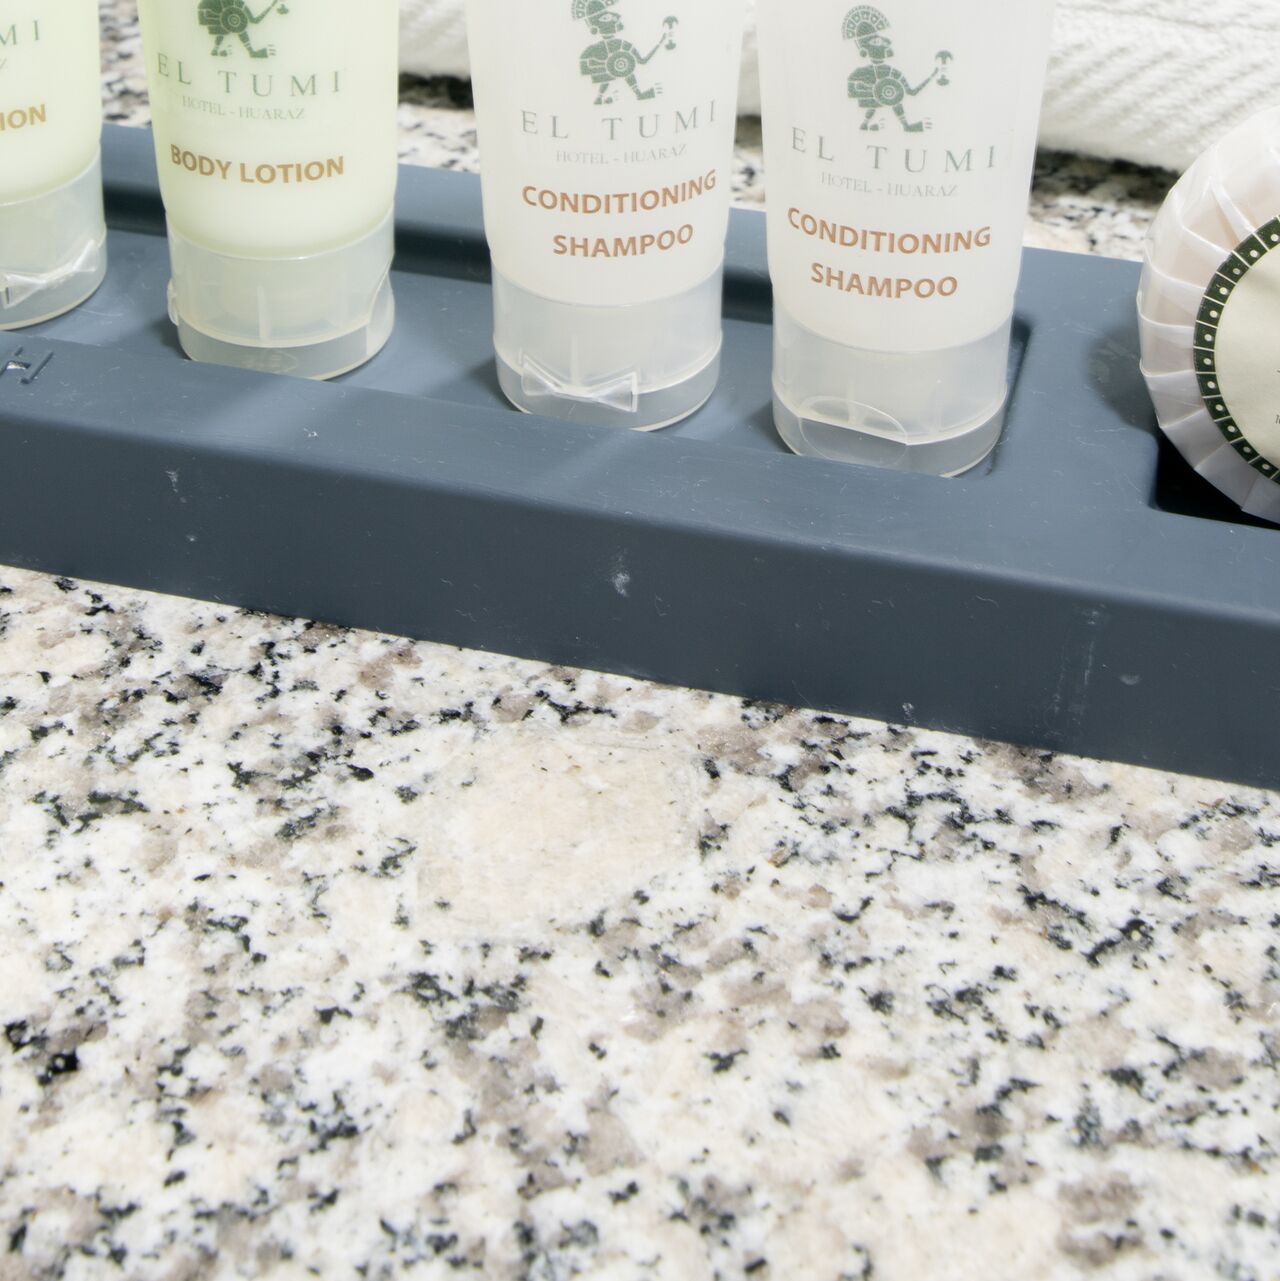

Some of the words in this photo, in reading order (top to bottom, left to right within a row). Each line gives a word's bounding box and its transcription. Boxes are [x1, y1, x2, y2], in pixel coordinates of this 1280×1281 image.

[157, 52, 191, 85] EL
[217, 69, 344, 97] TUMI
[181, 95, 227, 117] HOTEL
[238, 106, 305, 121] HUARAZ
[521, 109, 568, 139] EL
[601, 99, 716, 141] TUMI
[170, 143, 231, 180] BODY
[239, 155, 345, 184] LOTION
[555, 150, 609, 165] HOTEL
[623, 144, 688, 164] HUARAZ
[791, 126, 834, 161] EL
[866, 144, 995, 173] TUMI
[522, 169, 716, 214] CONDITIONING
[820, 171, 872, 194] HOTEL
[887, 183, 959, 198] HUARAZ
[552, 223, 693, 258] SHAMPOO
[787, 207, 991, 254] CONDITIONING
[810, 261, 959, 299] SHAMPOO
